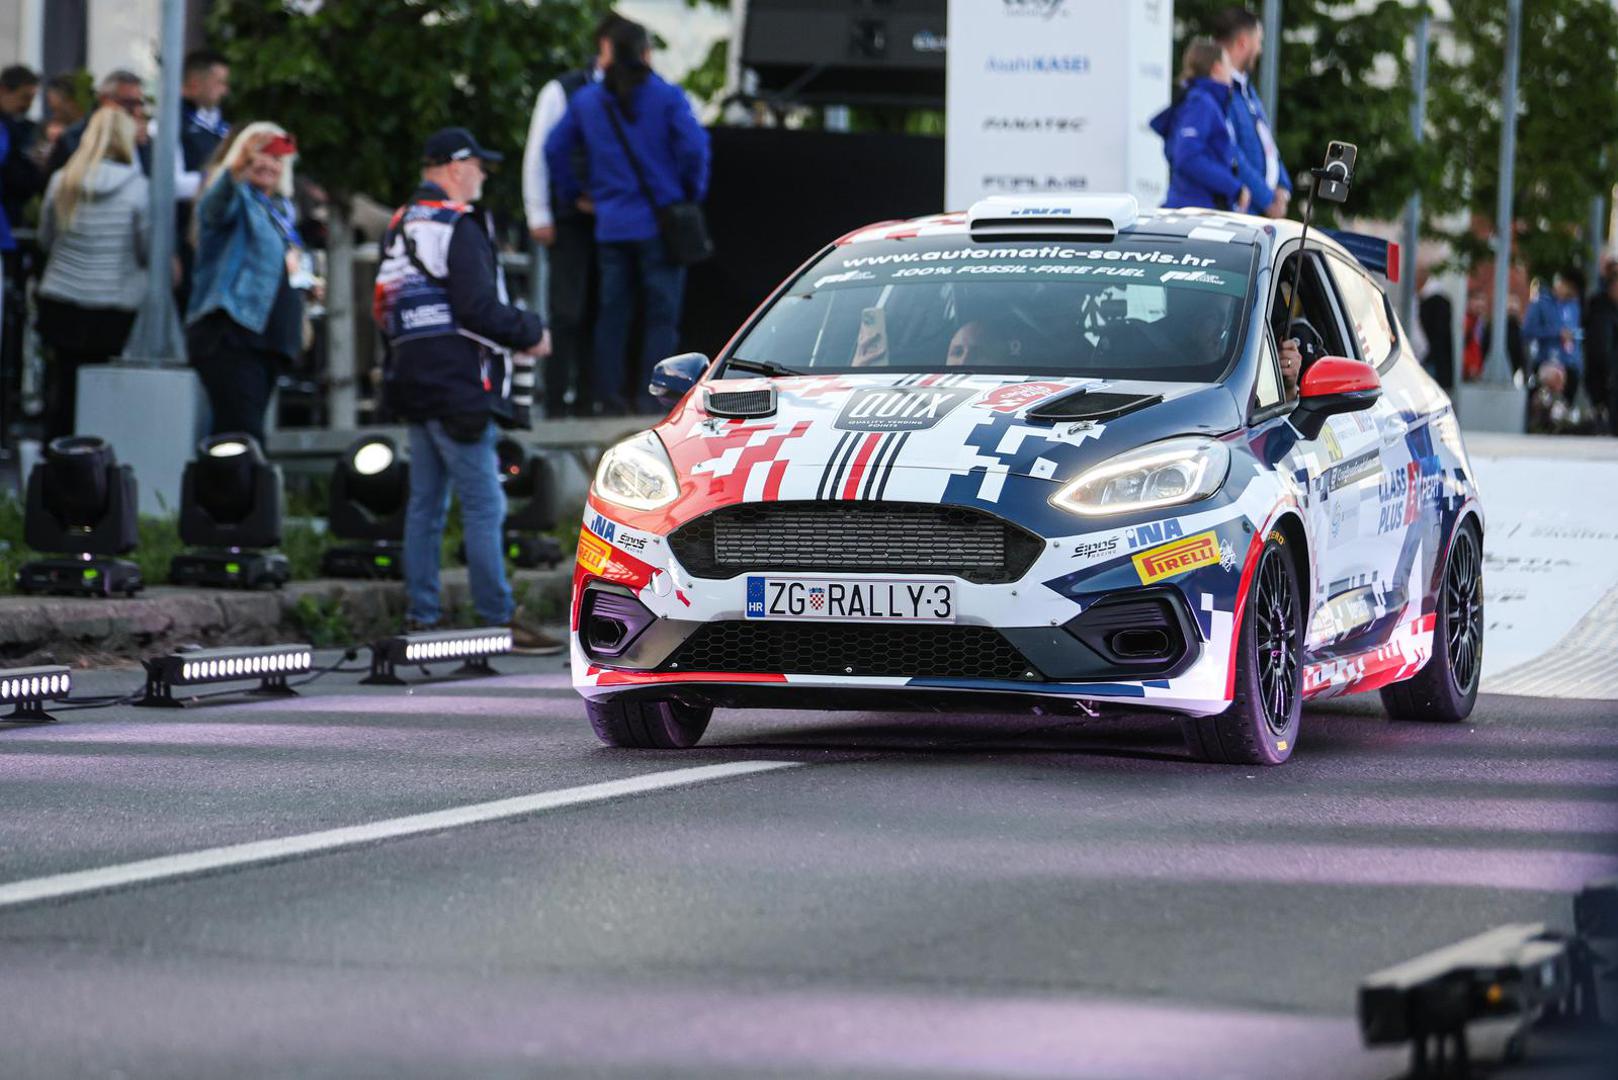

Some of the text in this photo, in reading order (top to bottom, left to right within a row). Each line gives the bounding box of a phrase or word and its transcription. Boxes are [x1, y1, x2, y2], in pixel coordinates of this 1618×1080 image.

[842, 246, 1217, 268] www.automatic-servis.hr
[891, 263, 1146, 278] 100% FOSSIL-FREE FUEL
[1377, 500, 1404, 535] PLUS
[1141, 537, 1214, 577] PIRELLI
[748, 601, 763, 612] HR
[769, 582, 805, 615] ZG
